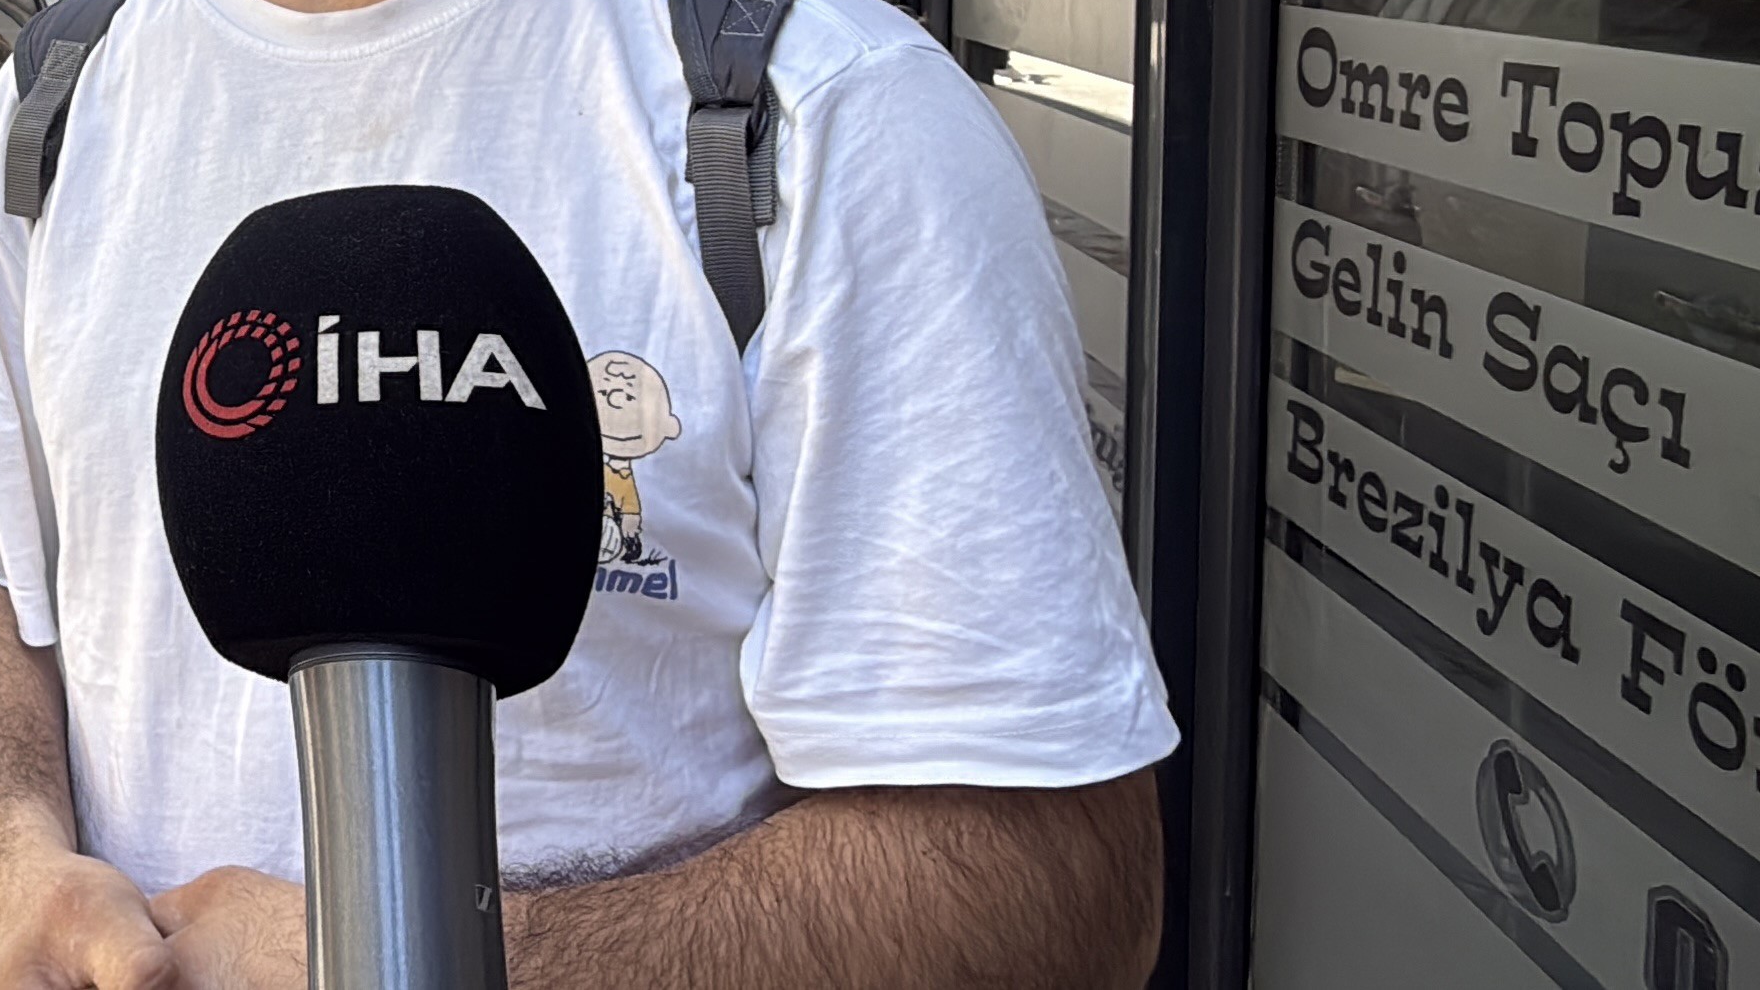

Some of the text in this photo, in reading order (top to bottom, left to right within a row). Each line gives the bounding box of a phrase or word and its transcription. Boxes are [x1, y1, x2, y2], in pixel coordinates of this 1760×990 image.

[1297, 27, 1760, 217] Omre Topu
[317, 315, 548, 411] İHA
[1291, 219, 1691, 474] Gelin Saçı
[1287, 400, 1760, 794] Brezilya Fö
